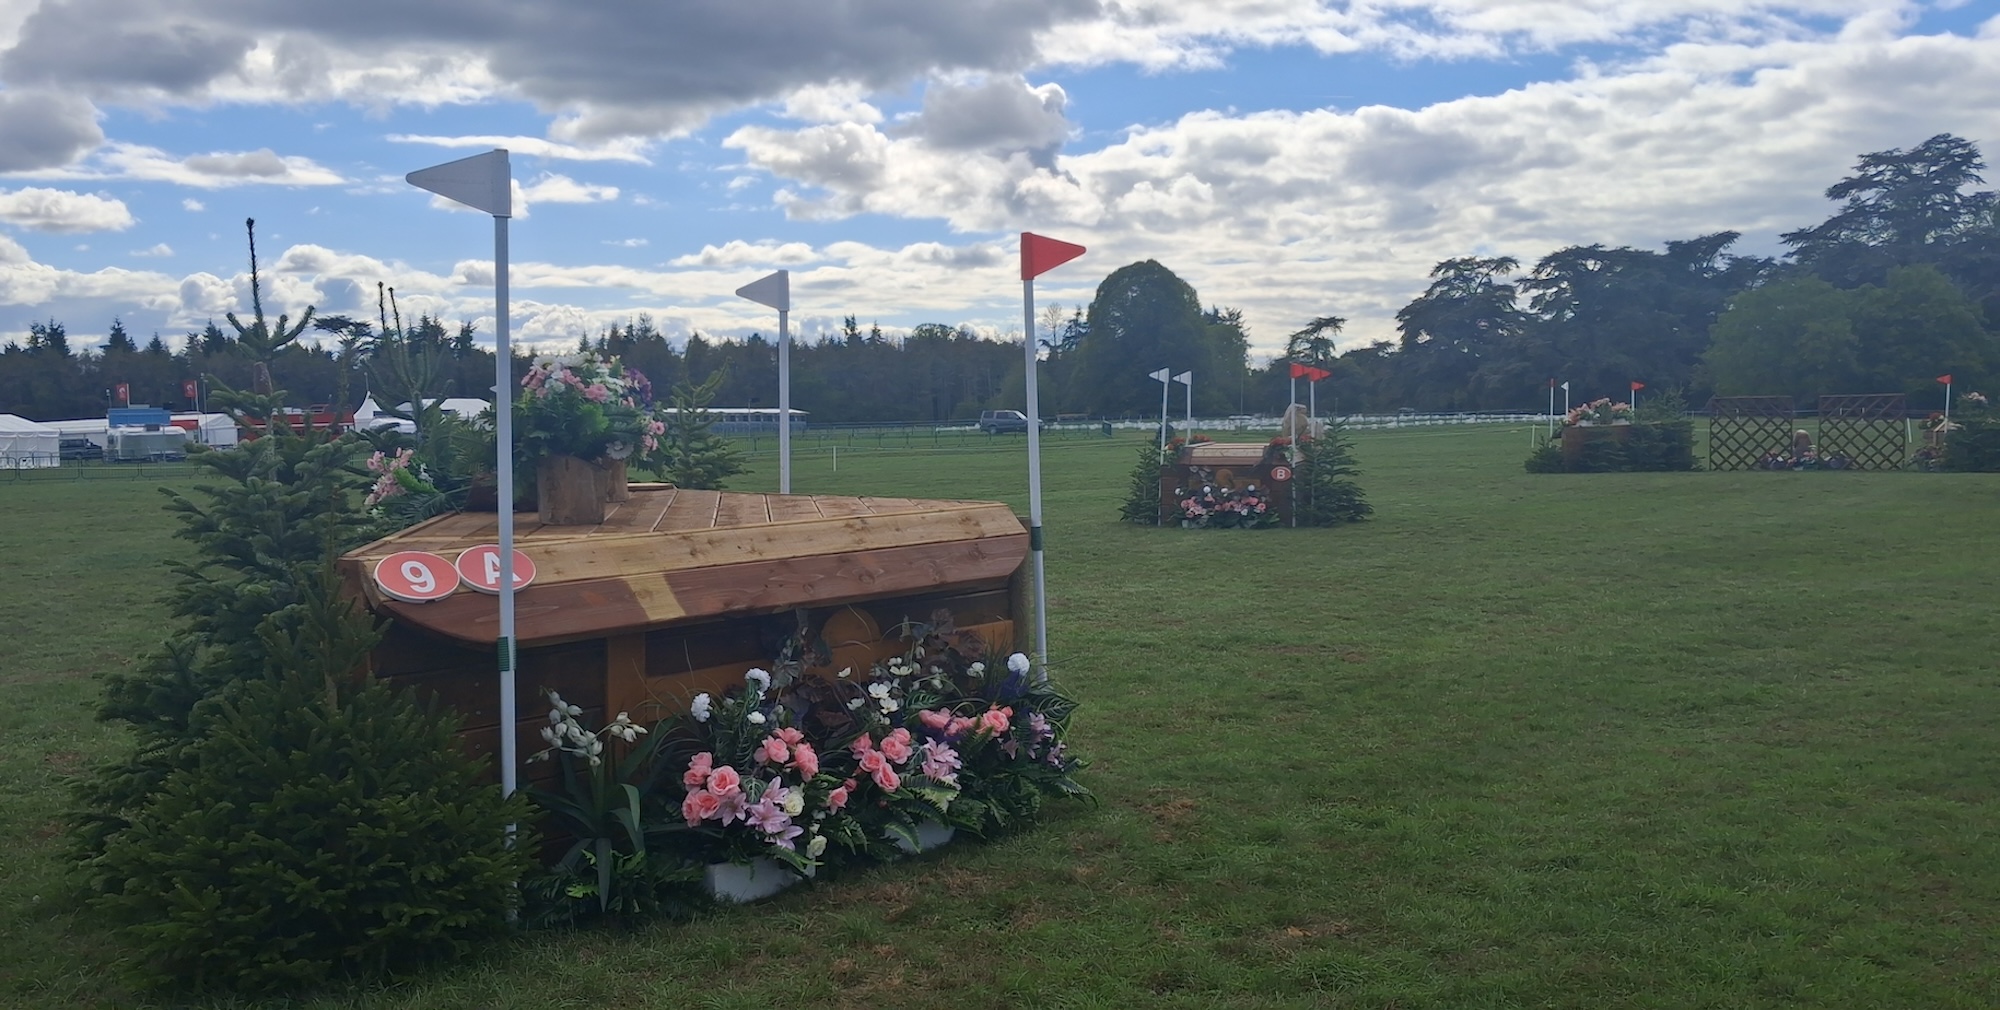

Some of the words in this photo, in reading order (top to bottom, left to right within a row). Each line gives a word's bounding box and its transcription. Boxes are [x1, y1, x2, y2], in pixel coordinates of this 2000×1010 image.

[1276, 469, 1286, 480] B
[400, 560, 436, 593] 9
[483, 551, 522, 585] A
